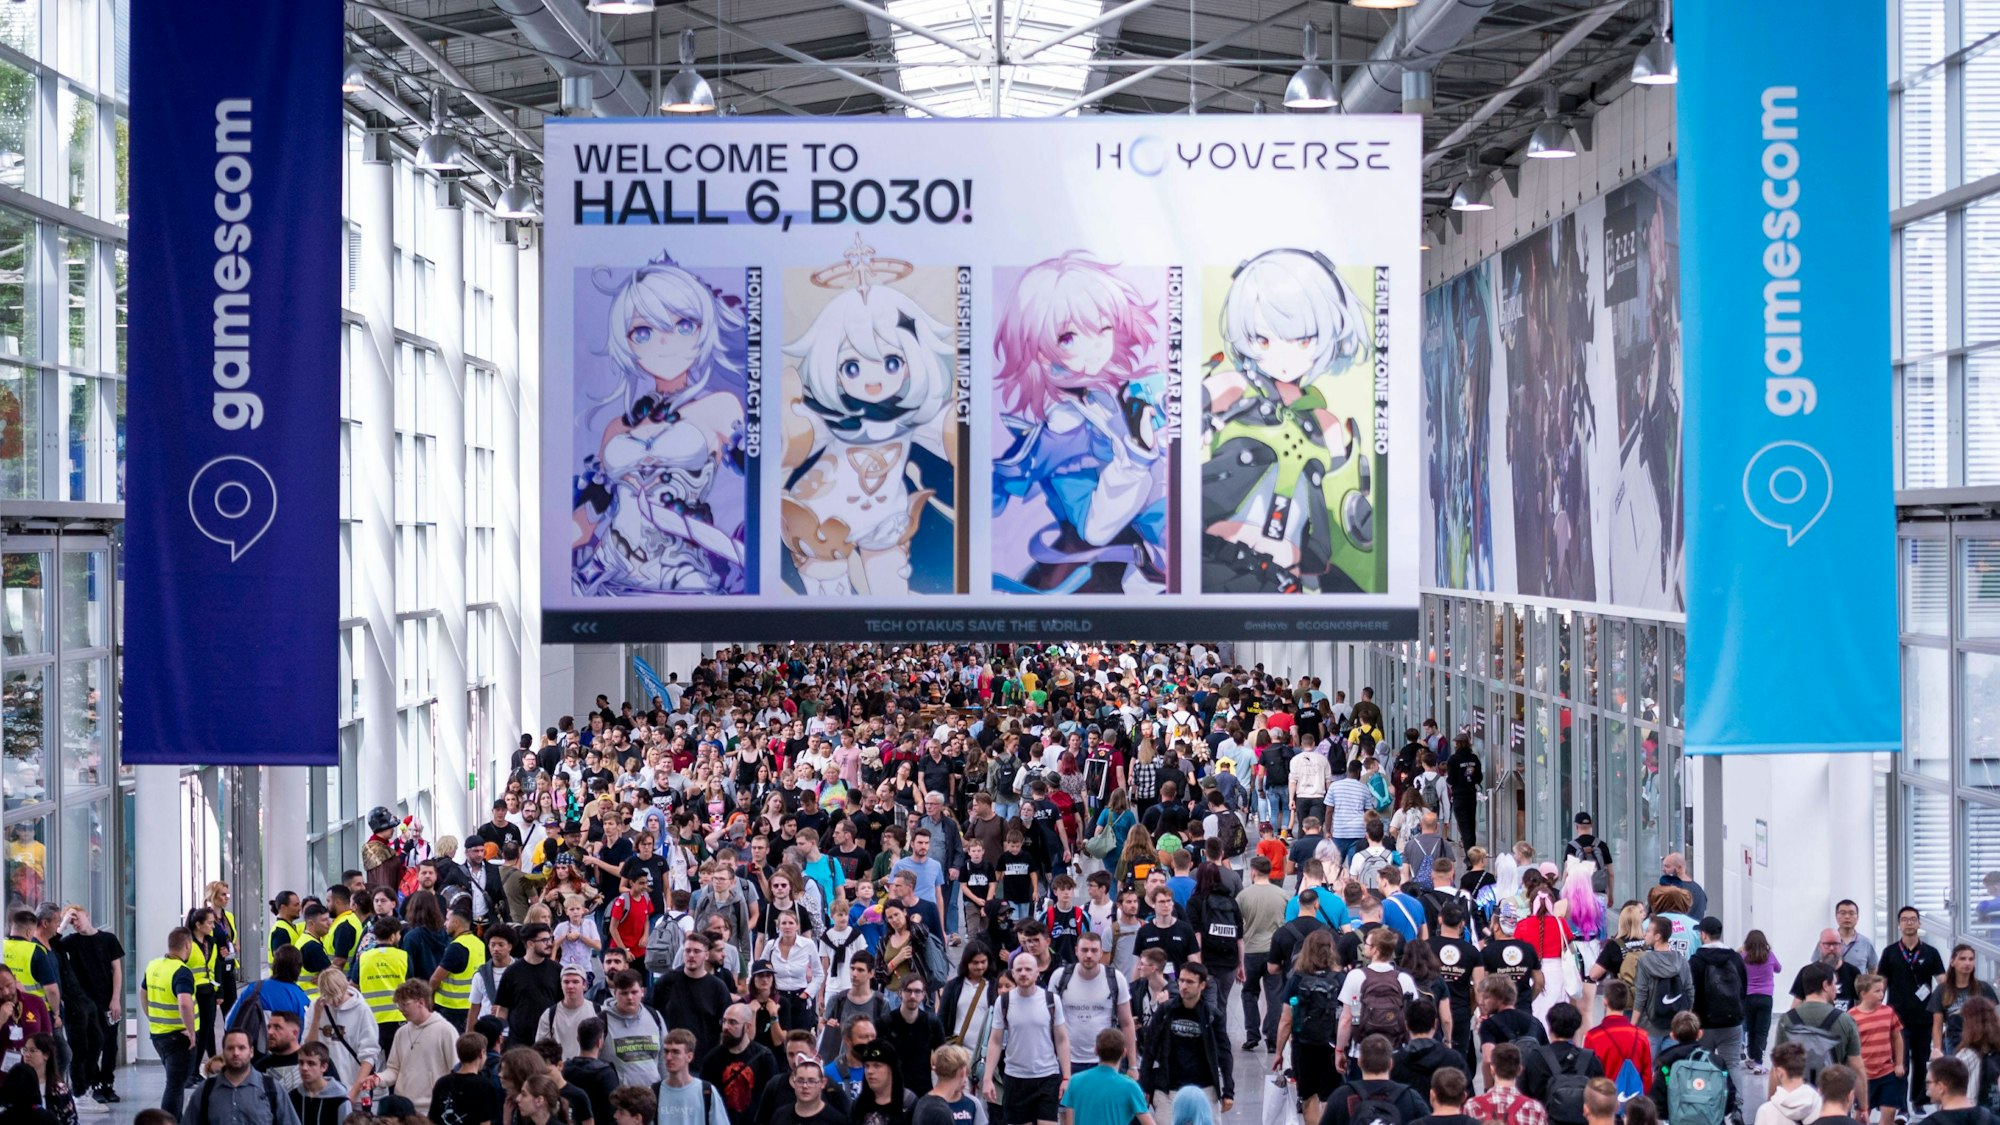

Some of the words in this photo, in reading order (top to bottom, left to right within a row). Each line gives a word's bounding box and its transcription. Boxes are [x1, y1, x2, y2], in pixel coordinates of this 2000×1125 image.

[574, 143, 788, 173] WELCOME
[802, 143, 859, 172] TO
[1096, 134, 1390, 177] HOYOVERSE
[573, 180, 729, 225] HALL
[745, 179, 793, 232] 6,
[810, 179, 973, 225] B030!
[212, 98, 264, 430] gamescom
[1761, 86, 1817, 416] gamescom
[747, 269, 760, 340] HONKAI
[957, 269, 970, 349] GENSHIN
[1168, 269, 1181, 344] HONKAI:
[1375, 269, 1388, 348] ZENLESS
[747, 347, 760, 417] IMPACT
[957, 355, 970, 425] IMPACT
[1168, 347, 1181, 397] STAR
[1375, 351, 1388, 401] ZONE
[747, 422, 760, 458] 3RD
[1168, 401, 1181, 443] RAIL
[1375, 406, 1388, 455] ZERO
[865, 619, 901, 632] TECH
[905, 619, 965, 632] OTAKUS
[967, 619, 1005, 632] SAVE
[1009, 619, 1036, 632] THE
[1040, 619, 1092, 632] WORLD
